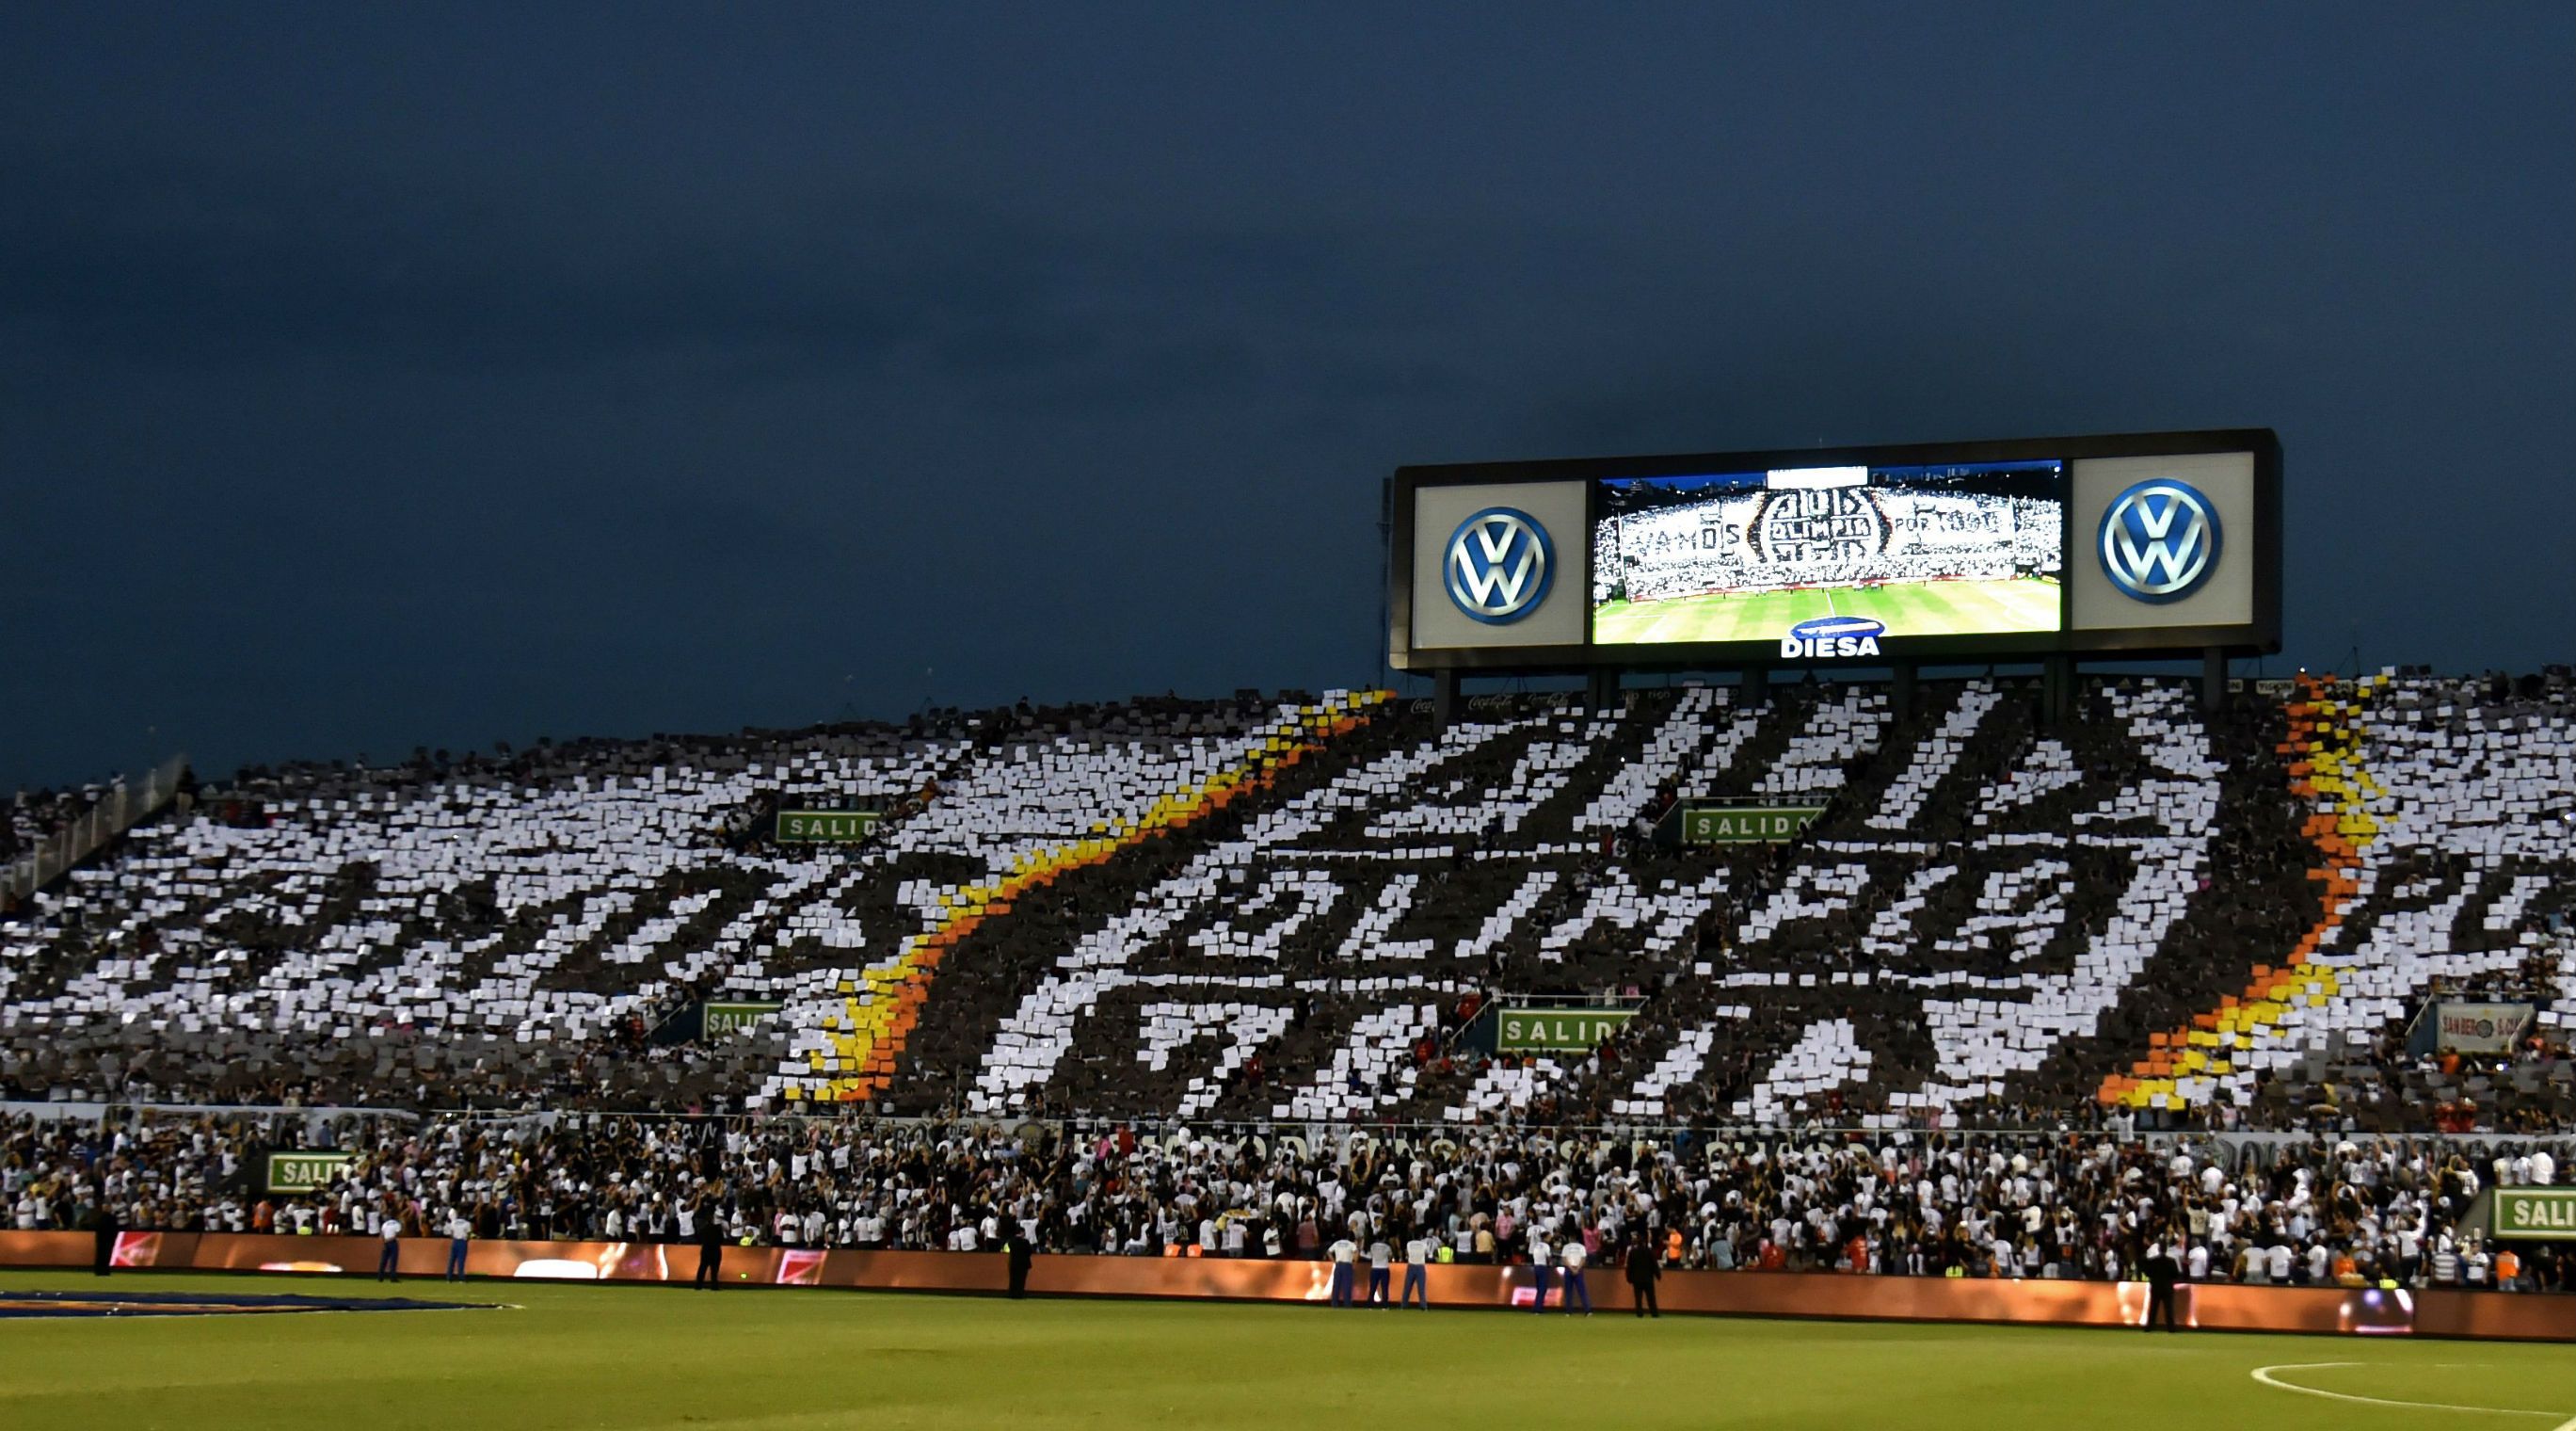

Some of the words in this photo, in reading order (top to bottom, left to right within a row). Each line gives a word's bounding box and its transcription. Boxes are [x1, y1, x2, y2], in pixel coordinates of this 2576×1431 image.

[1781, 637, 1880, 658] DIESA
[790, 818, 876, 836] SALID
[1506, 1021, 1613, 1041] SALID
